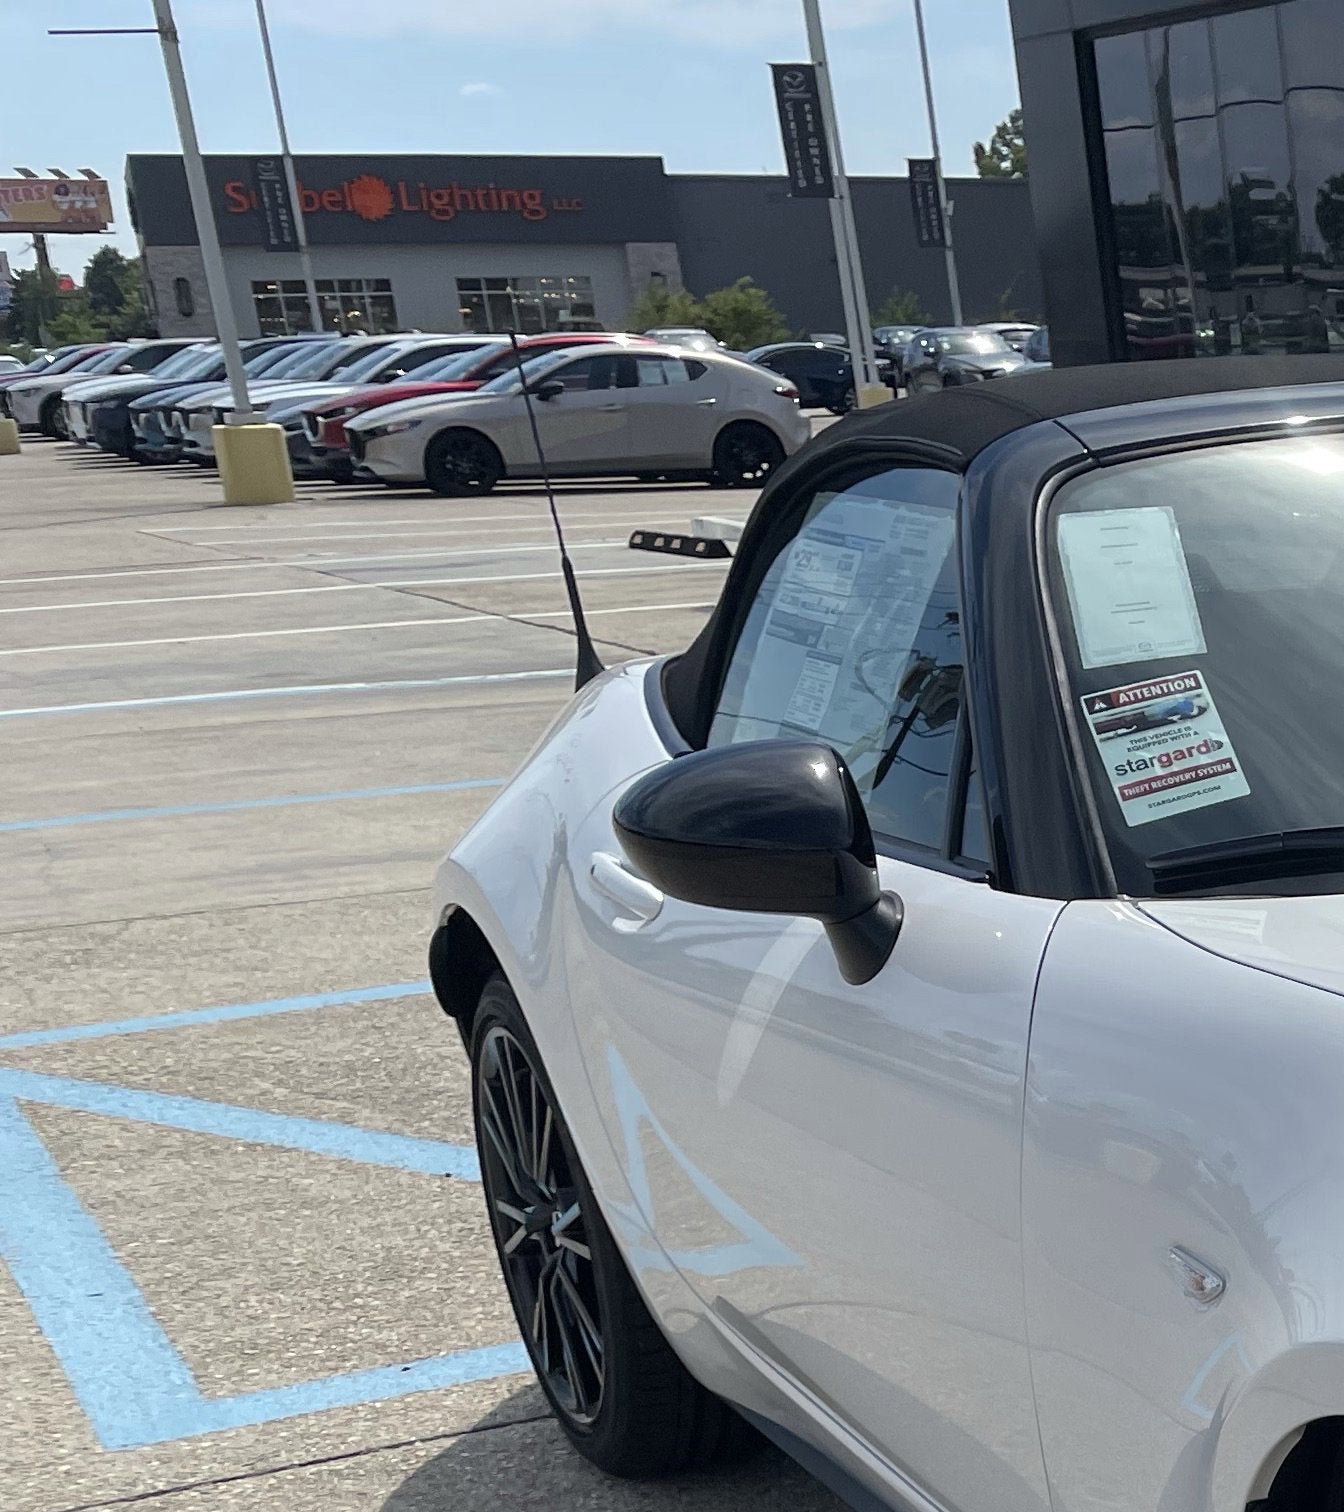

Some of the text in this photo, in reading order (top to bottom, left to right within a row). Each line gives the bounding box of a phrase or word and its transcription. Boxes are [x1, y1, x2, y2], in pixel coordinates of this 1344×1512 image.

[399, 182, 547, 220] Lighting
[1118, 677, 1197, 704] ATTENTION
[1127, 739, 1169, 753] EQUIPPED
[1170, 733, 1191, 743] WITH
[1129, 736, 1148, 745] THIS
[1149, 728, 1182, 742] VEHICLE
[1114, 739, 1211, 777] stargard
[1123, 761, 1232, 798] THEFT RECOVERY SYSTEM
